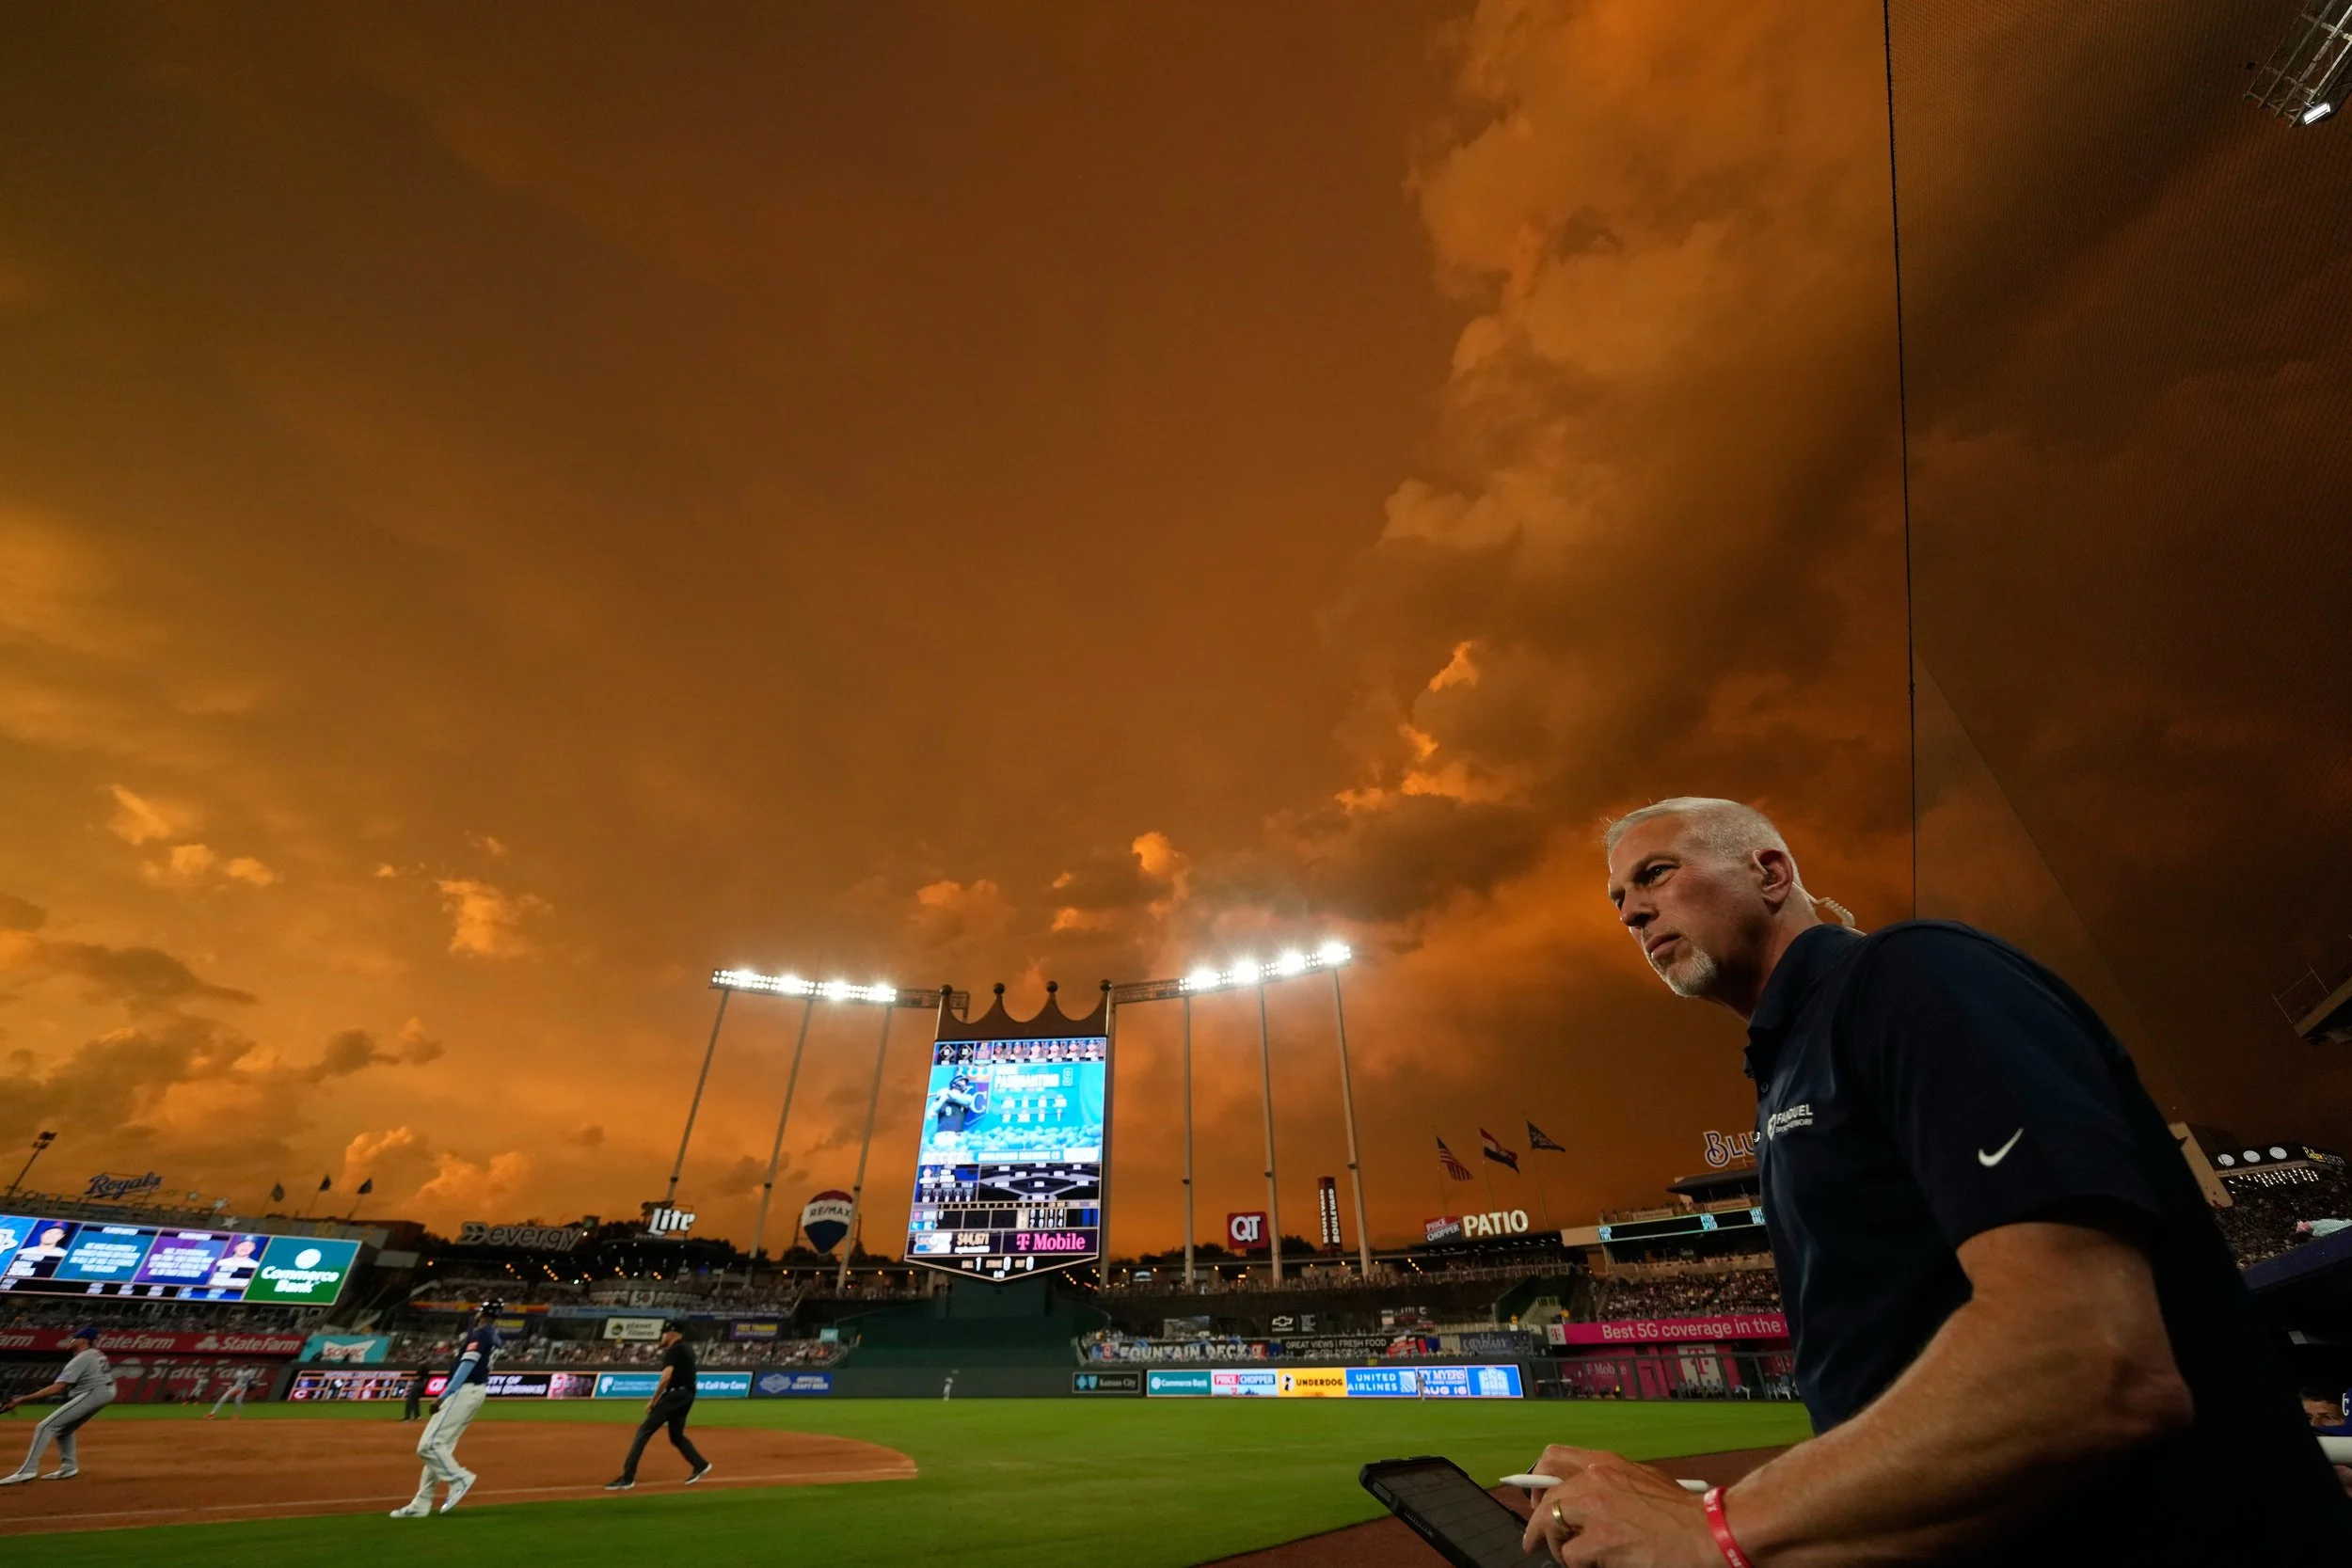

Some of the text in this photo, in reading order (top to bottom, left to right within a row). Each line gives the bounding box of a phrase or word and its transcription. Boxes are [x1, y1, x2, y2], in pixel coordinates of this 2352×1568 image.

[85, 1171, 161, 1200] Royals
[810, 1206, 851, 1217] RE/MAX
[1320, 1189, 1329, 1244] BOULEVARD
[1328, 1188, 1341, 1243] BOULEVARD
[647, 1208, 696, 1236] Lite
[1231, 1216, 1261, 1243] QT
[1426, 1218, 1446, 1231] PRICE
[1463, 1210, 1529, 1237] PATIO
[489, 1226, 583, 1252] evergy
[1427, 1224, 1460, 1241] CHOPPER
[1033, 1233, 1086, 1251] Mobile
[976, 1257, 981, 1271] 1
[261, 1266, 340, 1283] Commerce
[274, 1280, 314, 1293] Bank
[1602, 1318, 1782, 1339] Best 5G coverage in the
[1286, 1338, 1387, 1349] GREAT VIEWS FRESH FOOD
[325, 1347, 365, 1358] SONIC
[1120, 1344, 1200, 1359] FOUNTAIN
[1205, 1344, 1248, 1359] DECK
[1433, 1370, 1465, 1380] MYERS
[1595, 1362, 1628, 1375] Mobe
[1161, 1379, 1192, 1387] Commerce
[1355, 1373, 1396, 1382] UNITED
[1347, 1383, 1398, 1391] AIRLINES
